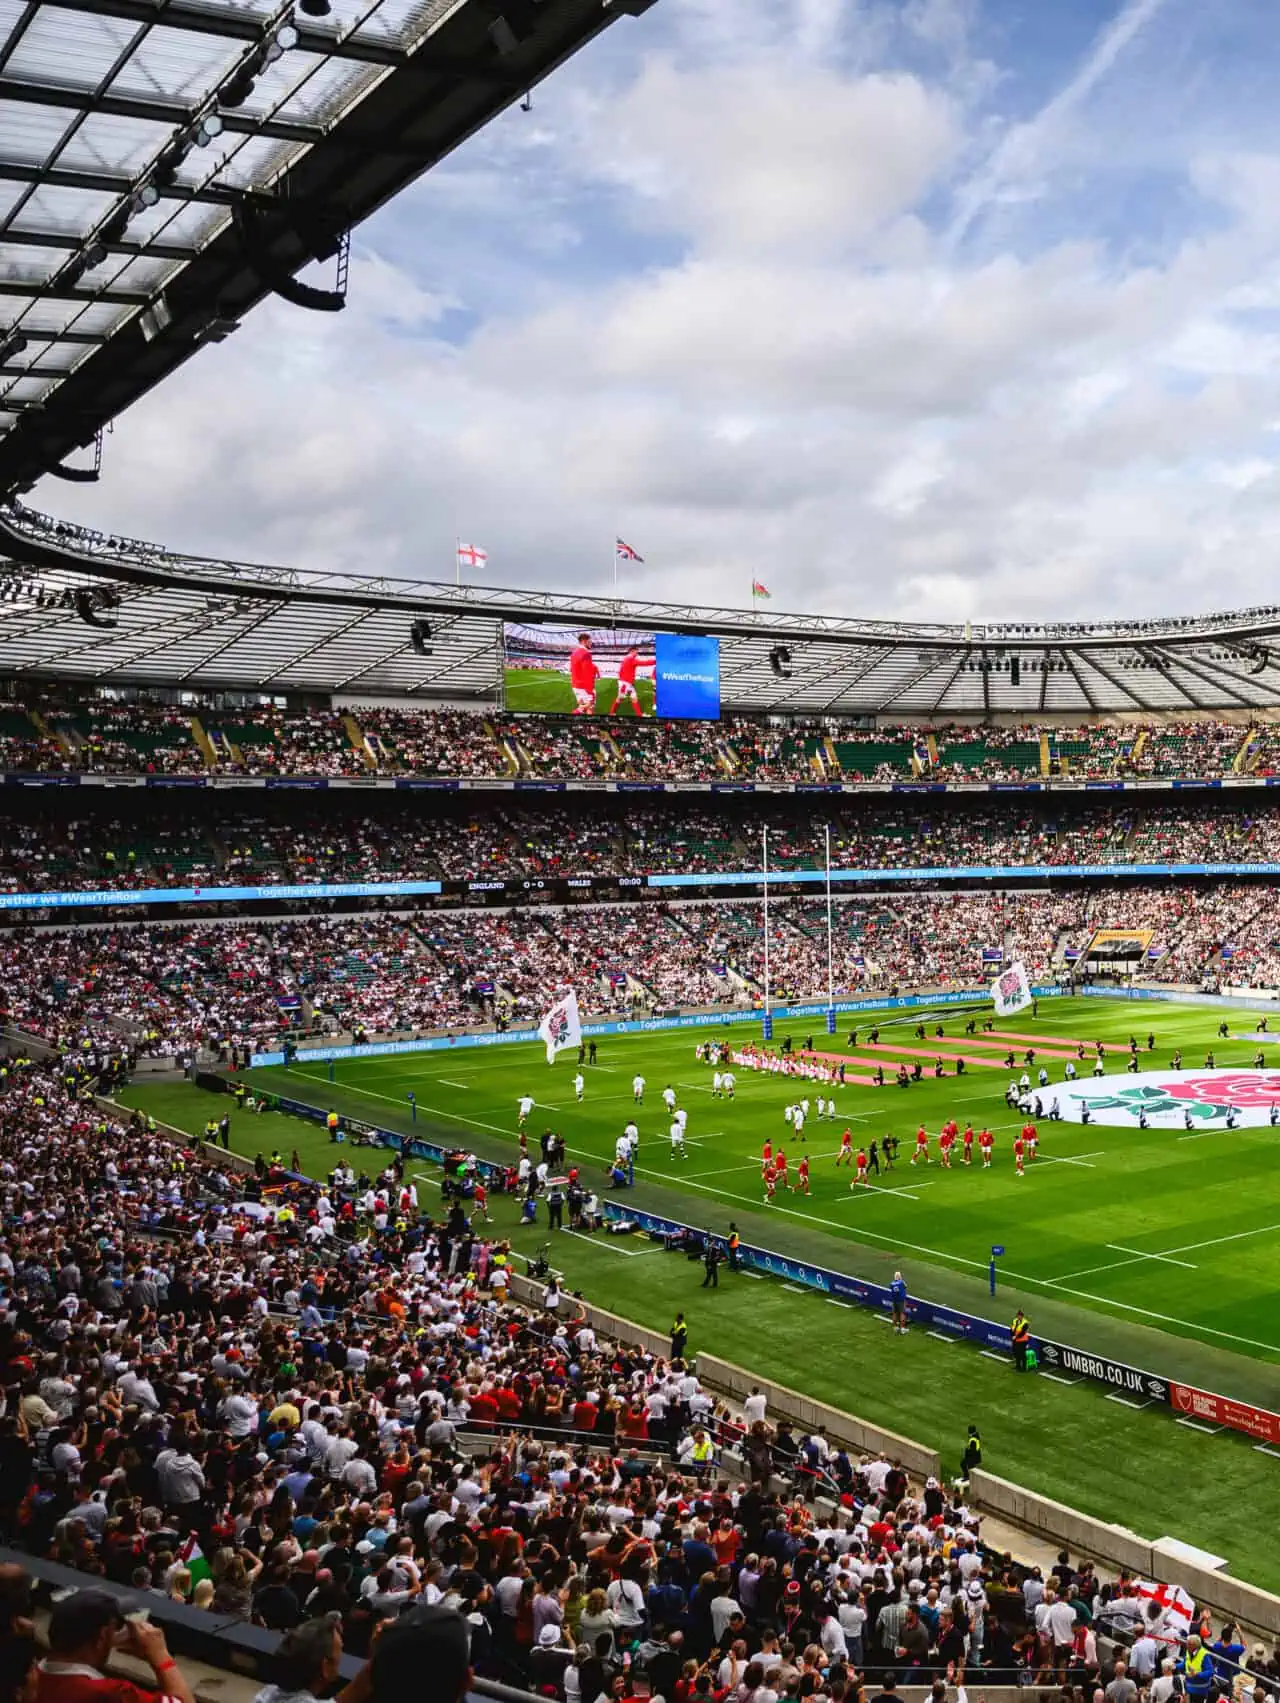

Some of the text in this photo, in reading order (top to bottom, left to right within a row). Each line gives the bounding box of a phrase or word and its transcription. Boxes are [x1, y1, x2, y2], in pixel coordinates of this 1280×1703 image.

[469, 882, 505, 890] ENGLAND
[567, 879, 592, 887] WALES
[619, 877, 641, 885] 00:00
[1062, 1350, 1144, 1393] UMBRO.CO.UK
